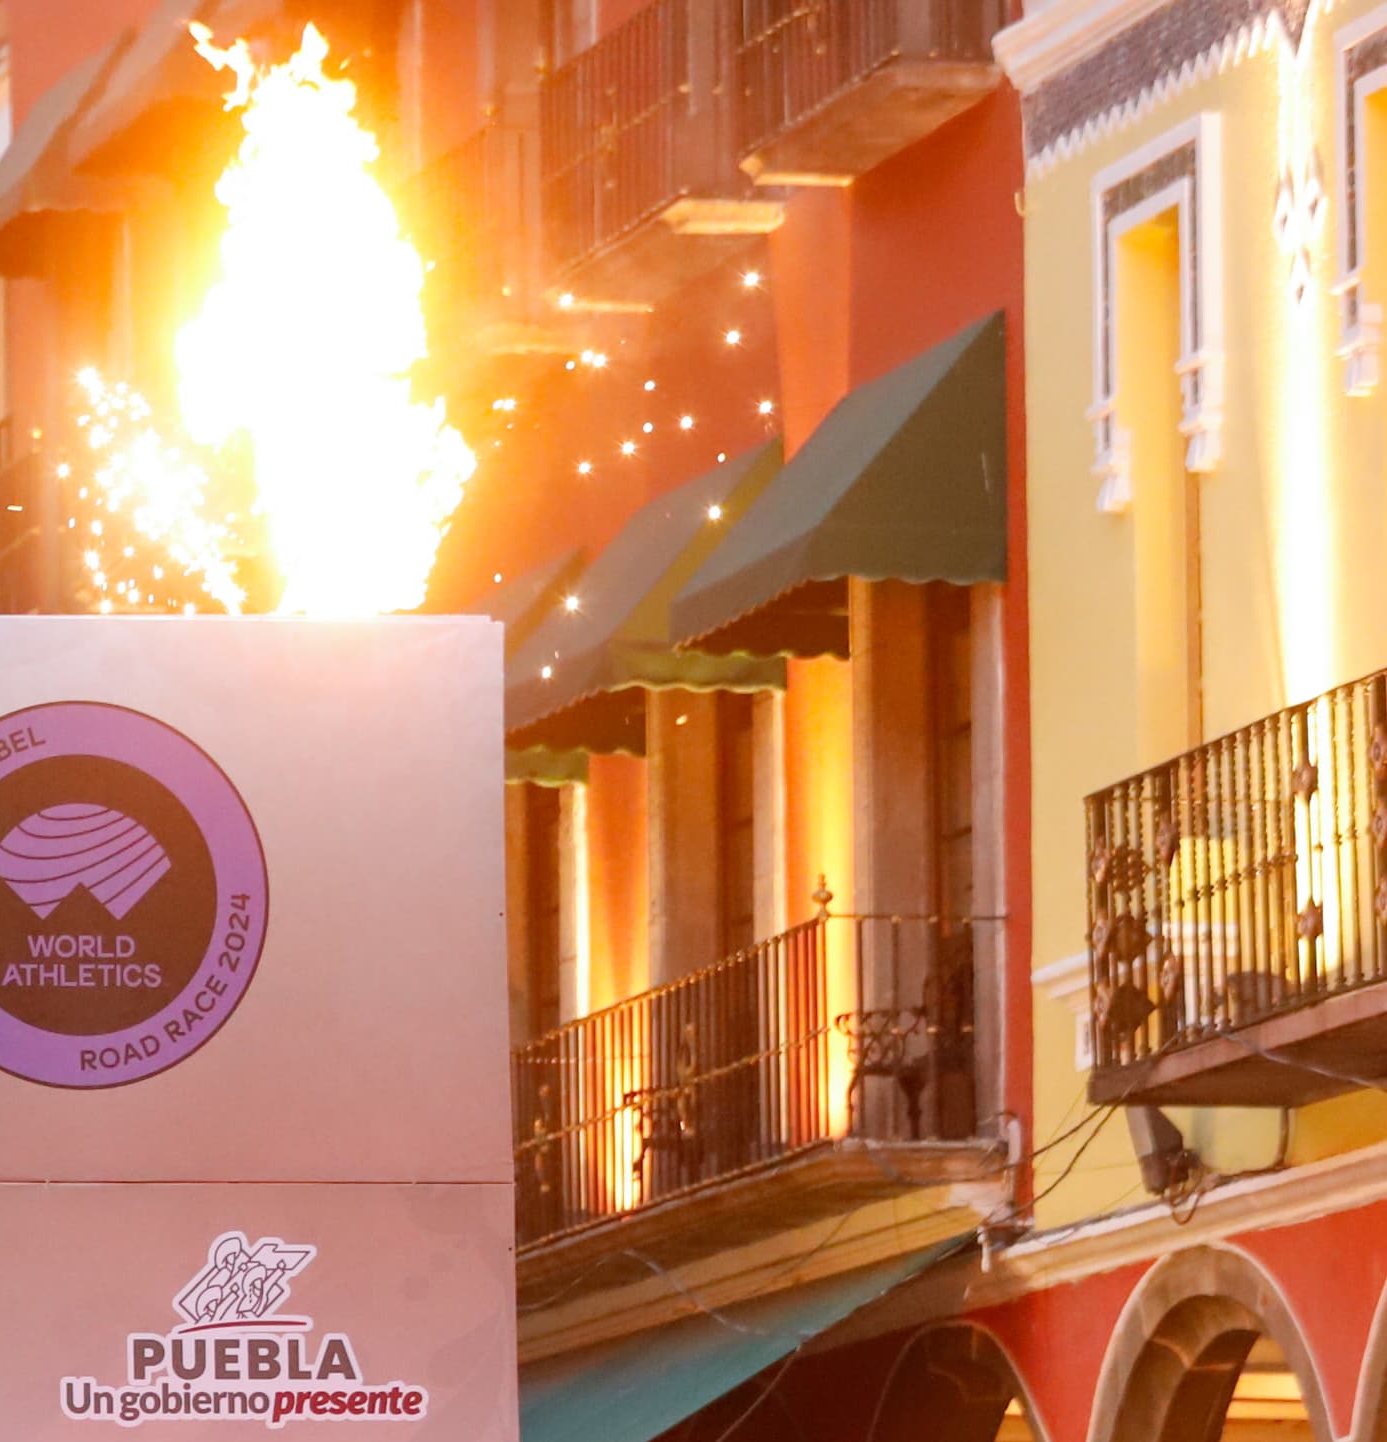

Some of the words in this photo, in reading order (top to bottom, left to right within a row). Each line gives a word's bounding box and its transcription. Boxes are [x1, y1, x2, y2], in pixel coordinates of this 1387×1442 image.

[28, 935, 136, 959] WORLD
[1, 964, 162, 987] ATHLETICS
[80, 1034, 161, 1072] ROAD
[164, 979, 230, 1044] RACE
[219, 892, 251, 973] 2024
[132, 1339, 357, 1381] PUEBLA
[65, 1383, 115, 1415] Un
[120, 1383, 269, 1422] gobierno
[272, 1386, 424, 1422] presente
